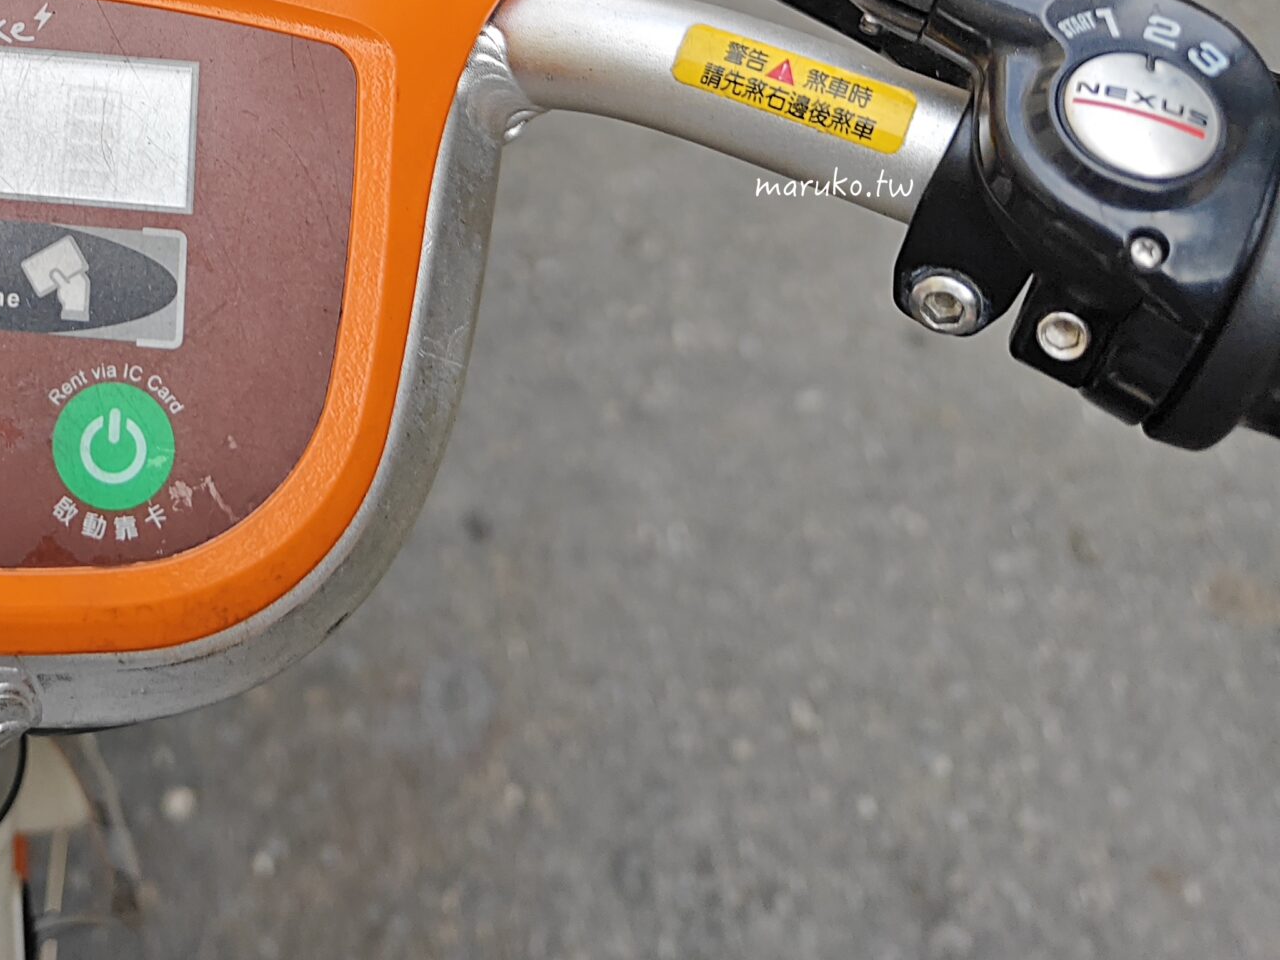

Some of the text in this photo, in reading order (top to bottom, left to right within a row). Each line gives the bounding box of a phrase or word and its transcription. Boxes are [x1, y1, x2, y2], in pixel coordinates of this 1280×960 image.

[1057, 7, 1231, 78] START 1 2 3
[699, 62, 878, 142] 請先煞右邊後煞車
[723, 40, 874, 110] 警告 煞車時
[1076, 81, 1209, 128] NEXUS
[48, 362, 185, 415] Rent via IC Card
[52, 495, 167, 541] 啟動靠卡
